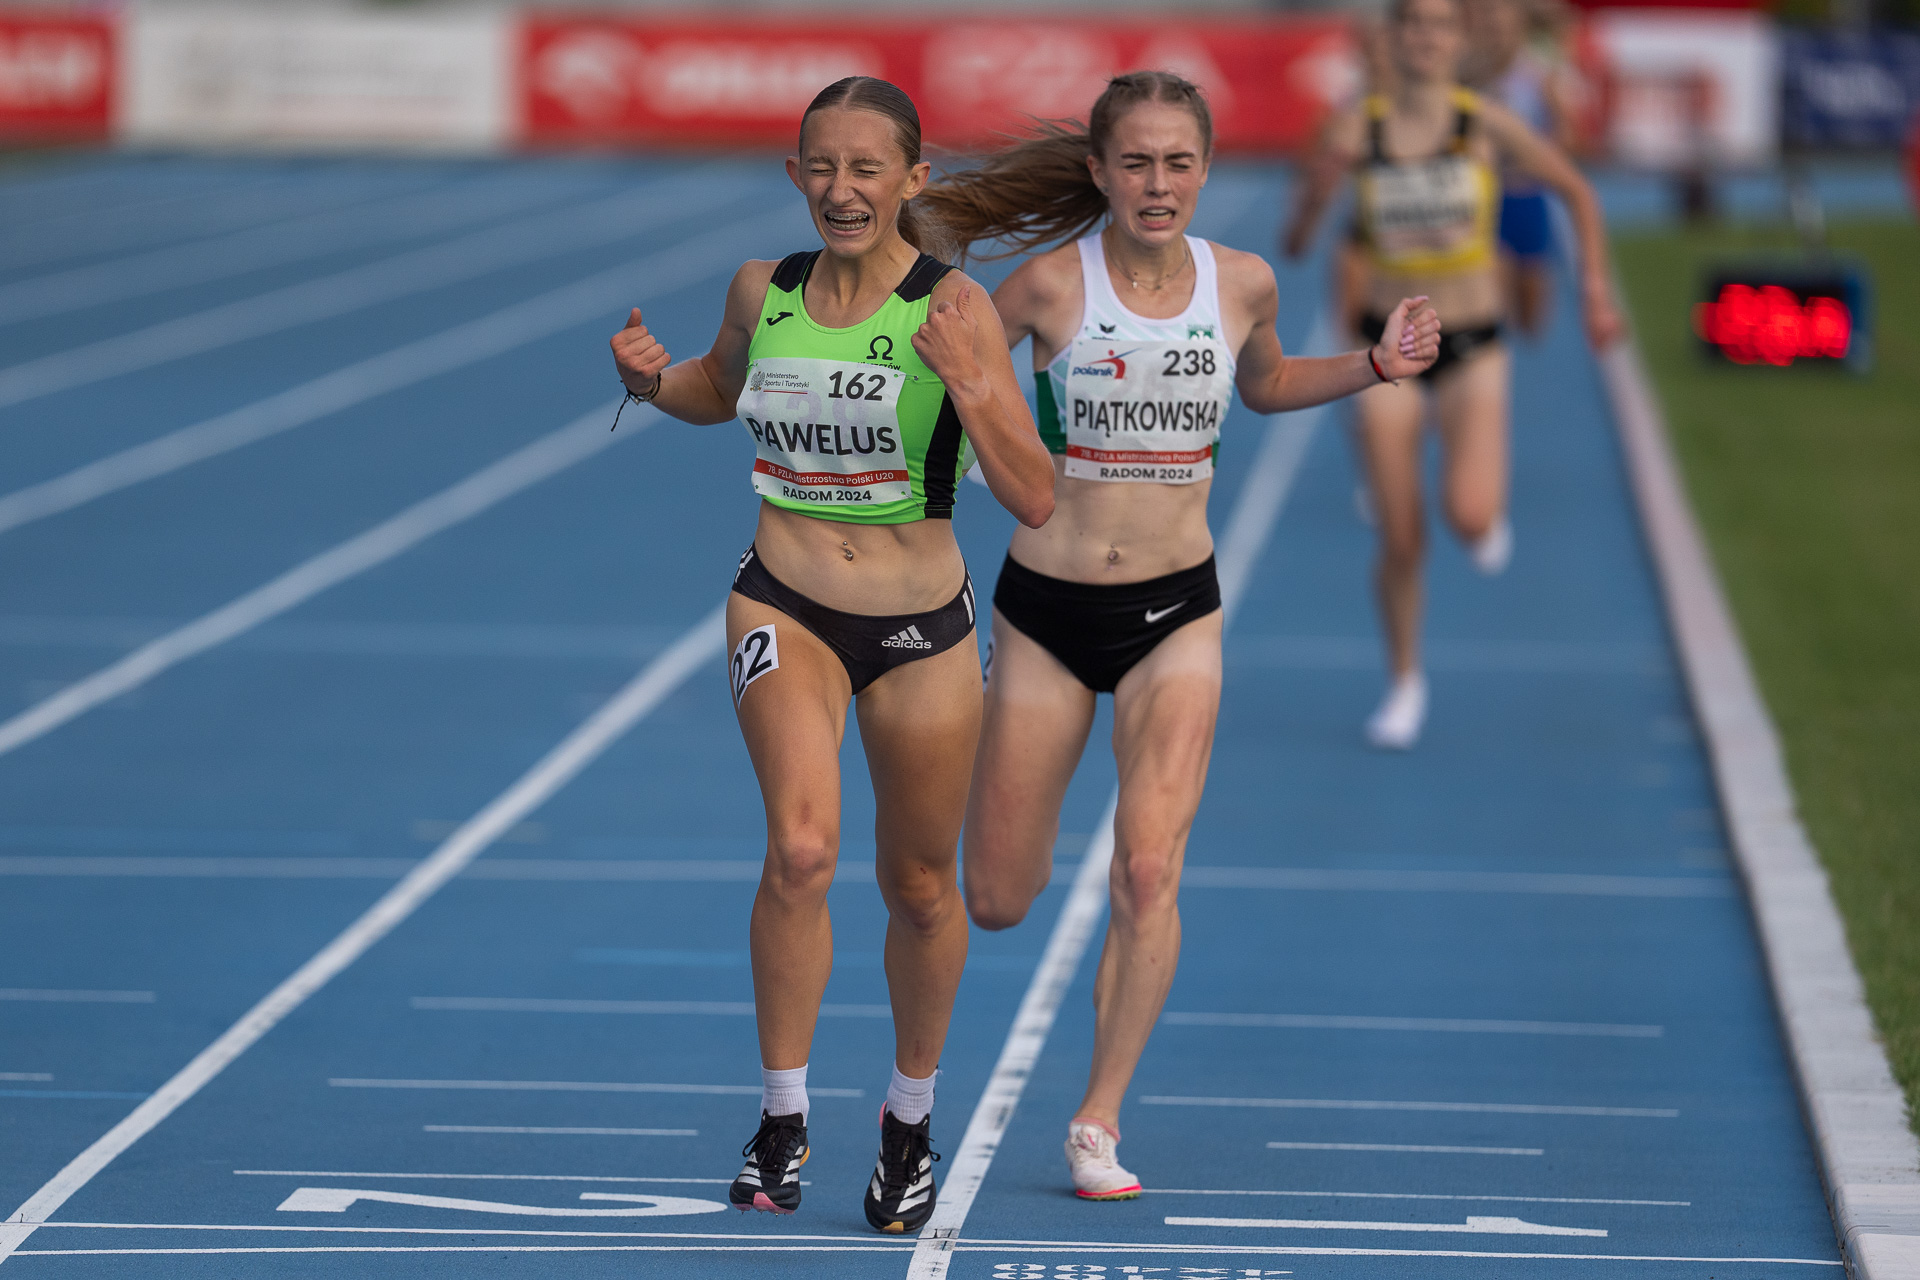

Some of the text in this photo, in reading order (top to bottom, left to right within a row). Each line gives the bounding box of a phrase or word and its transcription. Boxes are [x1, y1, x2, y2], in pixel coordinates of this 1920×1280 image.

[1072, 366, 1114, 376] polanik
[1162, 349, 1216, 376] 238
[766, 372, 799, 380] Ministerstwo
[785, 380, 810, 388] Turystyki
[828, 370, 886, 401] 162
[1074, 398, 1218, 438] PIĄTKOWSKA
[746, 417, 897, 456] PAWELUS
[768, 464, 894, 485] 78. PZLA Mistrzostwa Polski U20
[1100, 467, 1193, 480] RADOM 2024
[783, 485, 873, 502] RADOM 2024
[881, 638, 932, 649] adidas
[275, 1187, 728, 1217] 2
